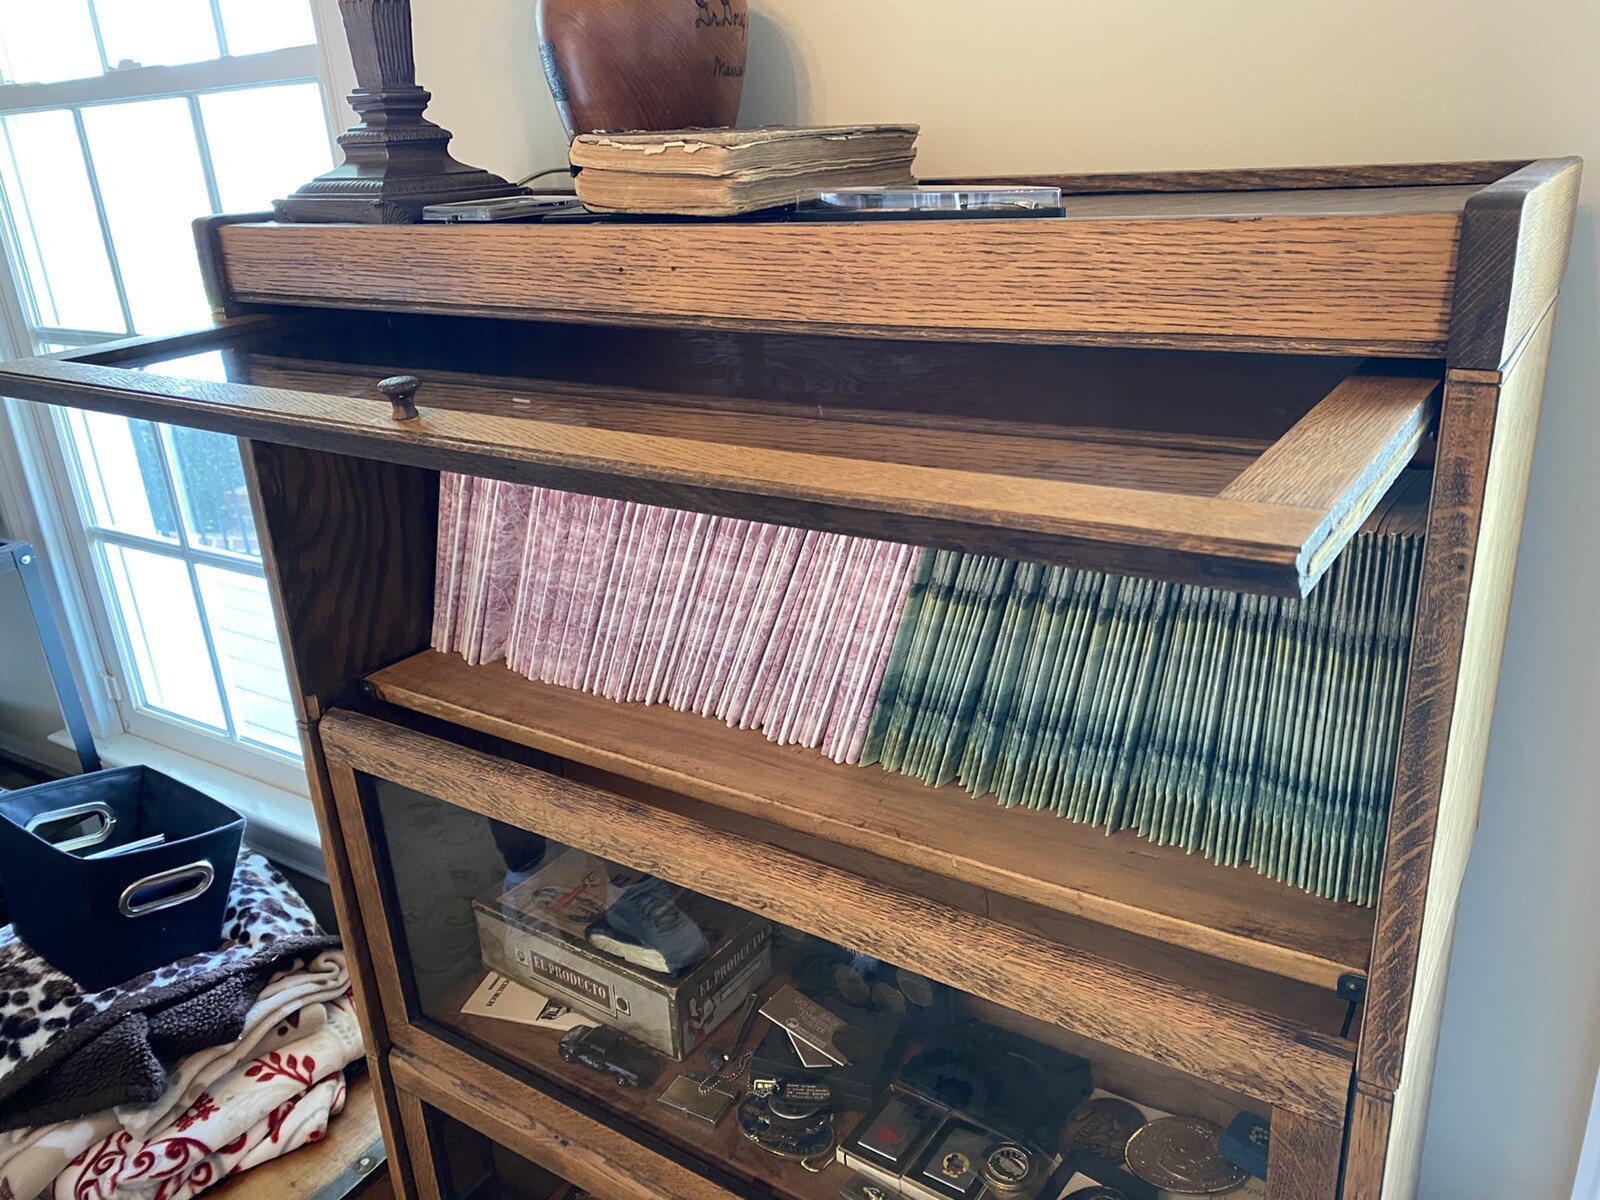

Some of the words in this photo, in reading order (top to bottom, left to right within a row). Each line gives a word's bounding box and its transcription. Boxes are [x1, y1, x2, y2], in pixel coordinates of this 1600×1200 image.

[533, 956, 547, 972] EL
[548, 962, 607, 999] PRODUCTO
[699, 979, 712, 997] EL
[714, 930, 765, 984] PRODUCTO
